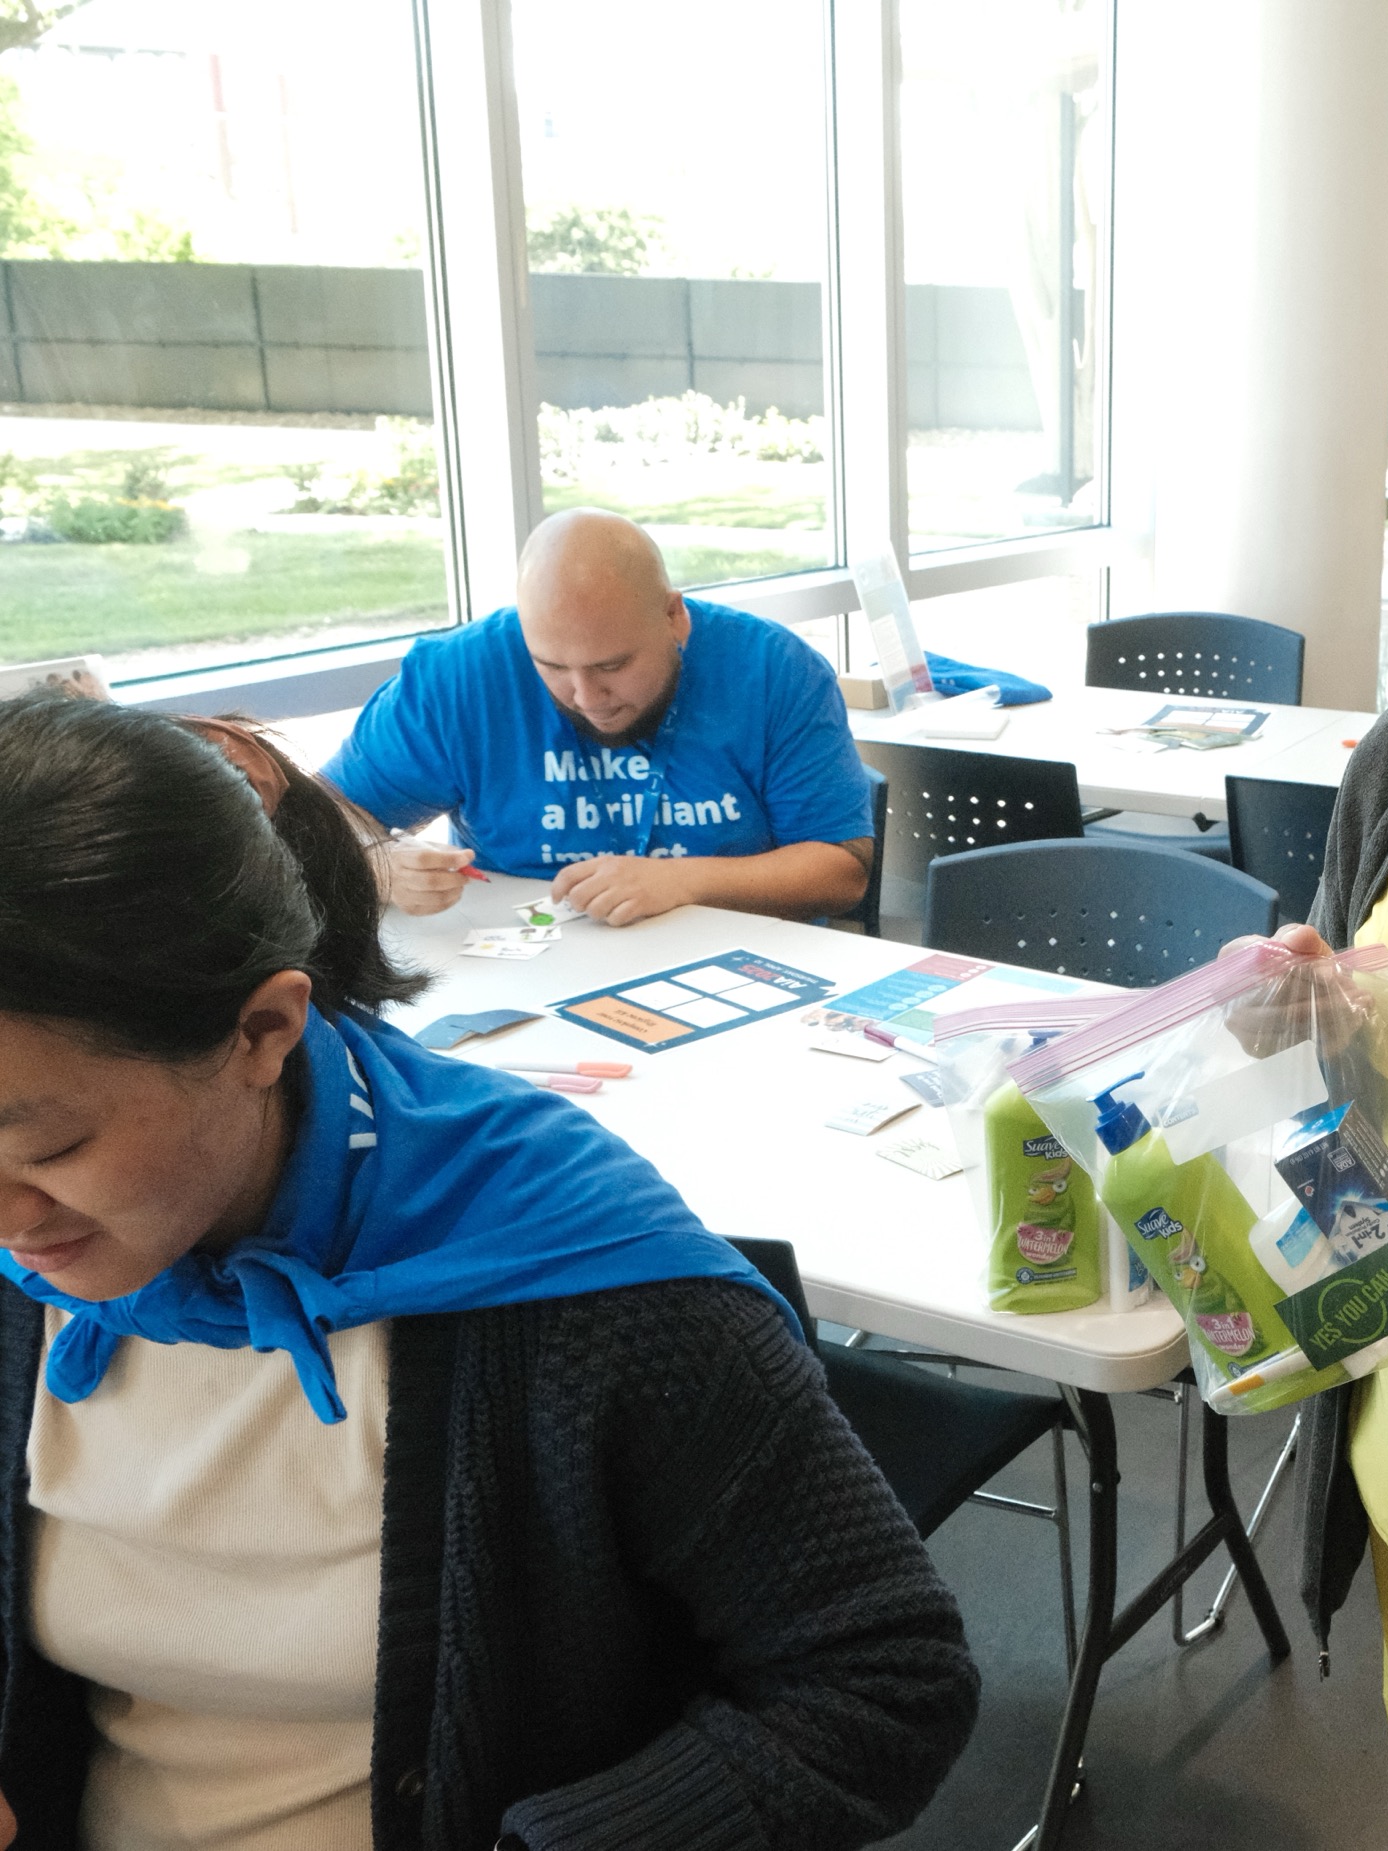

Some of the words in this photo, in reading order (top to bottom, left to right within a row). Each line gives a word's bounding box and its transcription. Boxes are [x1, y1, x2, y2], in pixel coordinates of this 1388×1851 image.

[543, 748, 651, 783] Make
[541, 803, 566, 831] a
[575, 792, 742, 830] briliant
[1026, 1139, 1062, 1153] Suave
[1045, 1148, 1069, 1160] kids
[1137, 1212, 1169, 1236] Suave
[1158, 1221, 1183, 1239] kids
[1351, 1223, 1386, 1249] 2-in-1
[1018, 1235, 1069, 1255] WATERMELON
[1309, 1321, 1343, 1351] YES
[1334, 1295, 1369, 1327] YOU
